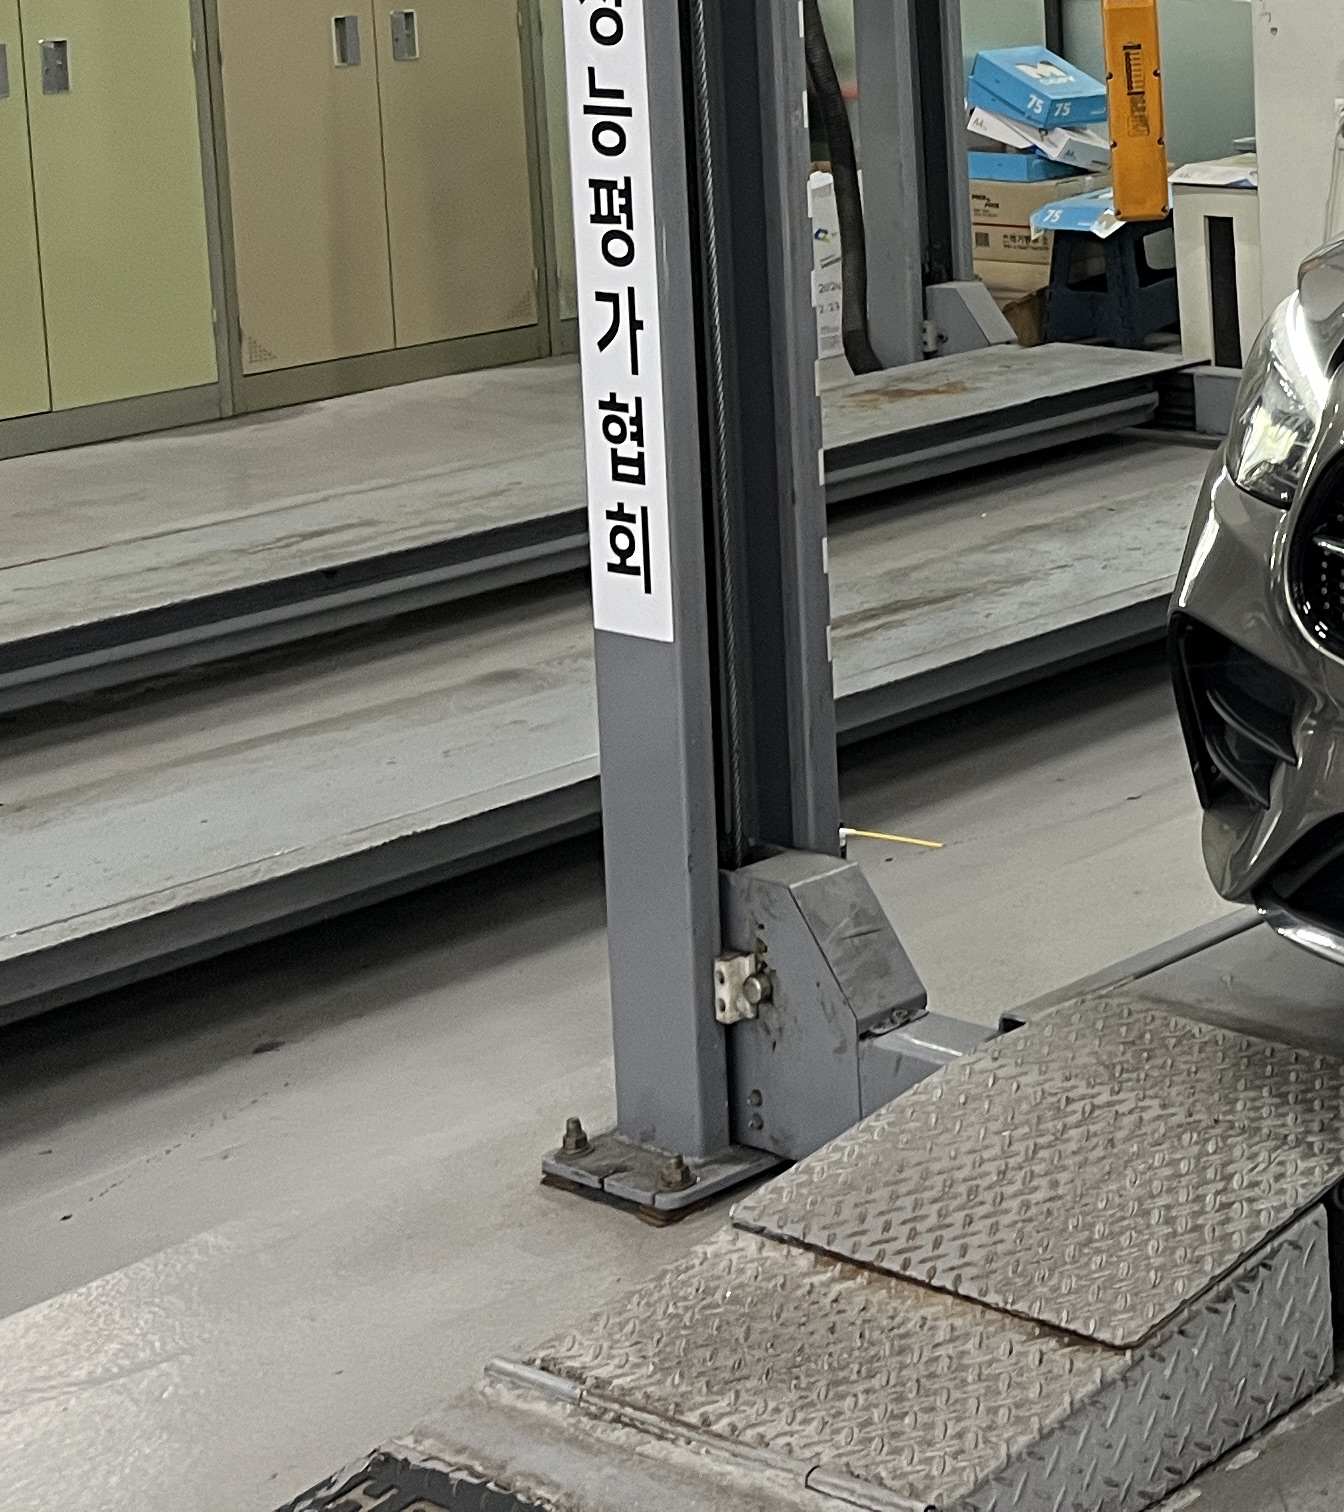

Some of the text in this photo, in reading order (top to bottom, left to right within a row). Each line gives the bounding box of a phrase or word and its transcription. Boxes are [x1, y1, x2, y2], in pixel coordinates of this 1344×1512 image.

[1027, 93, 1044, 114] 75
[1054, 102, 1071, 116] 75
[1043, 209, 1063, 222] 75
